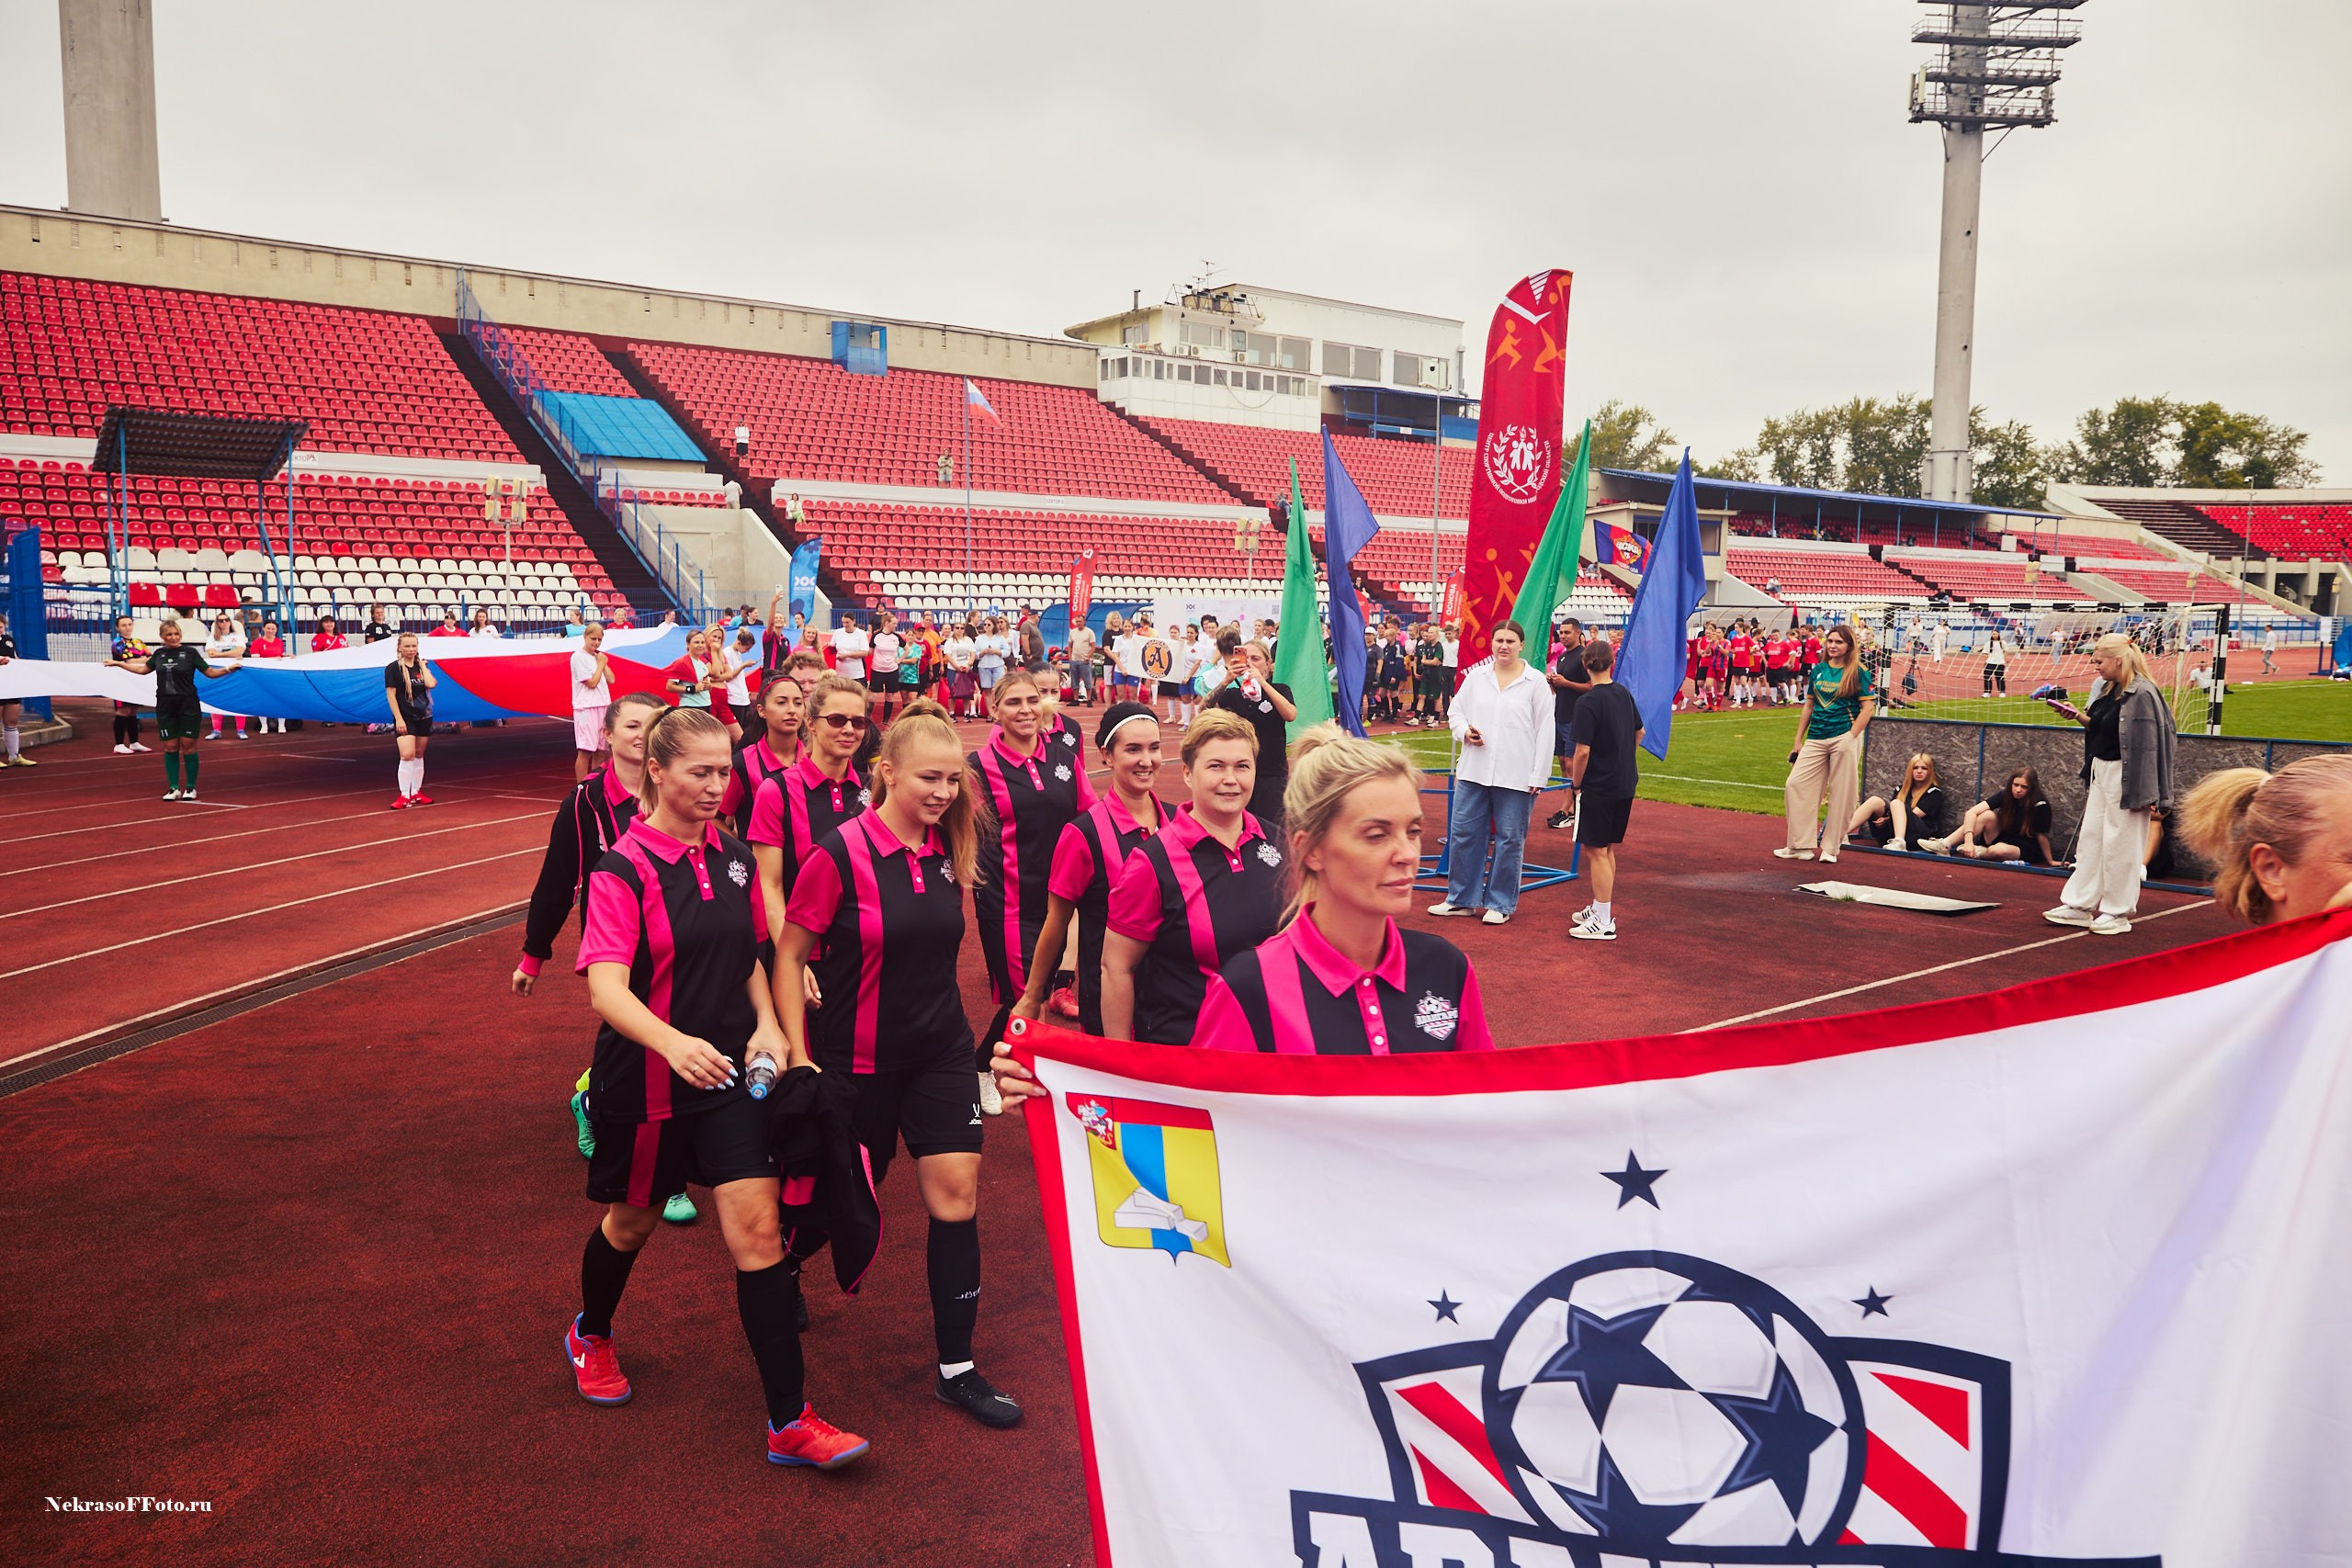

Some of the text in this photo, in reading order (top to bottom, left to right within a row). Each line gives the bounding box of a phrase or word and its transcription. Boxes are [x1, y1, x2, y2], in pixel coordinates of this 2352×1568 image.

[1484, 432, 1495, 452] ЦЕНТР
[1615, 541, 1640, 555] ЦСКА
[1071, 572, 1083, 612] ОСНОВА
[1445, 583, 1458, 615] ОСНОВА
[160, 728, 169, 738] 11
